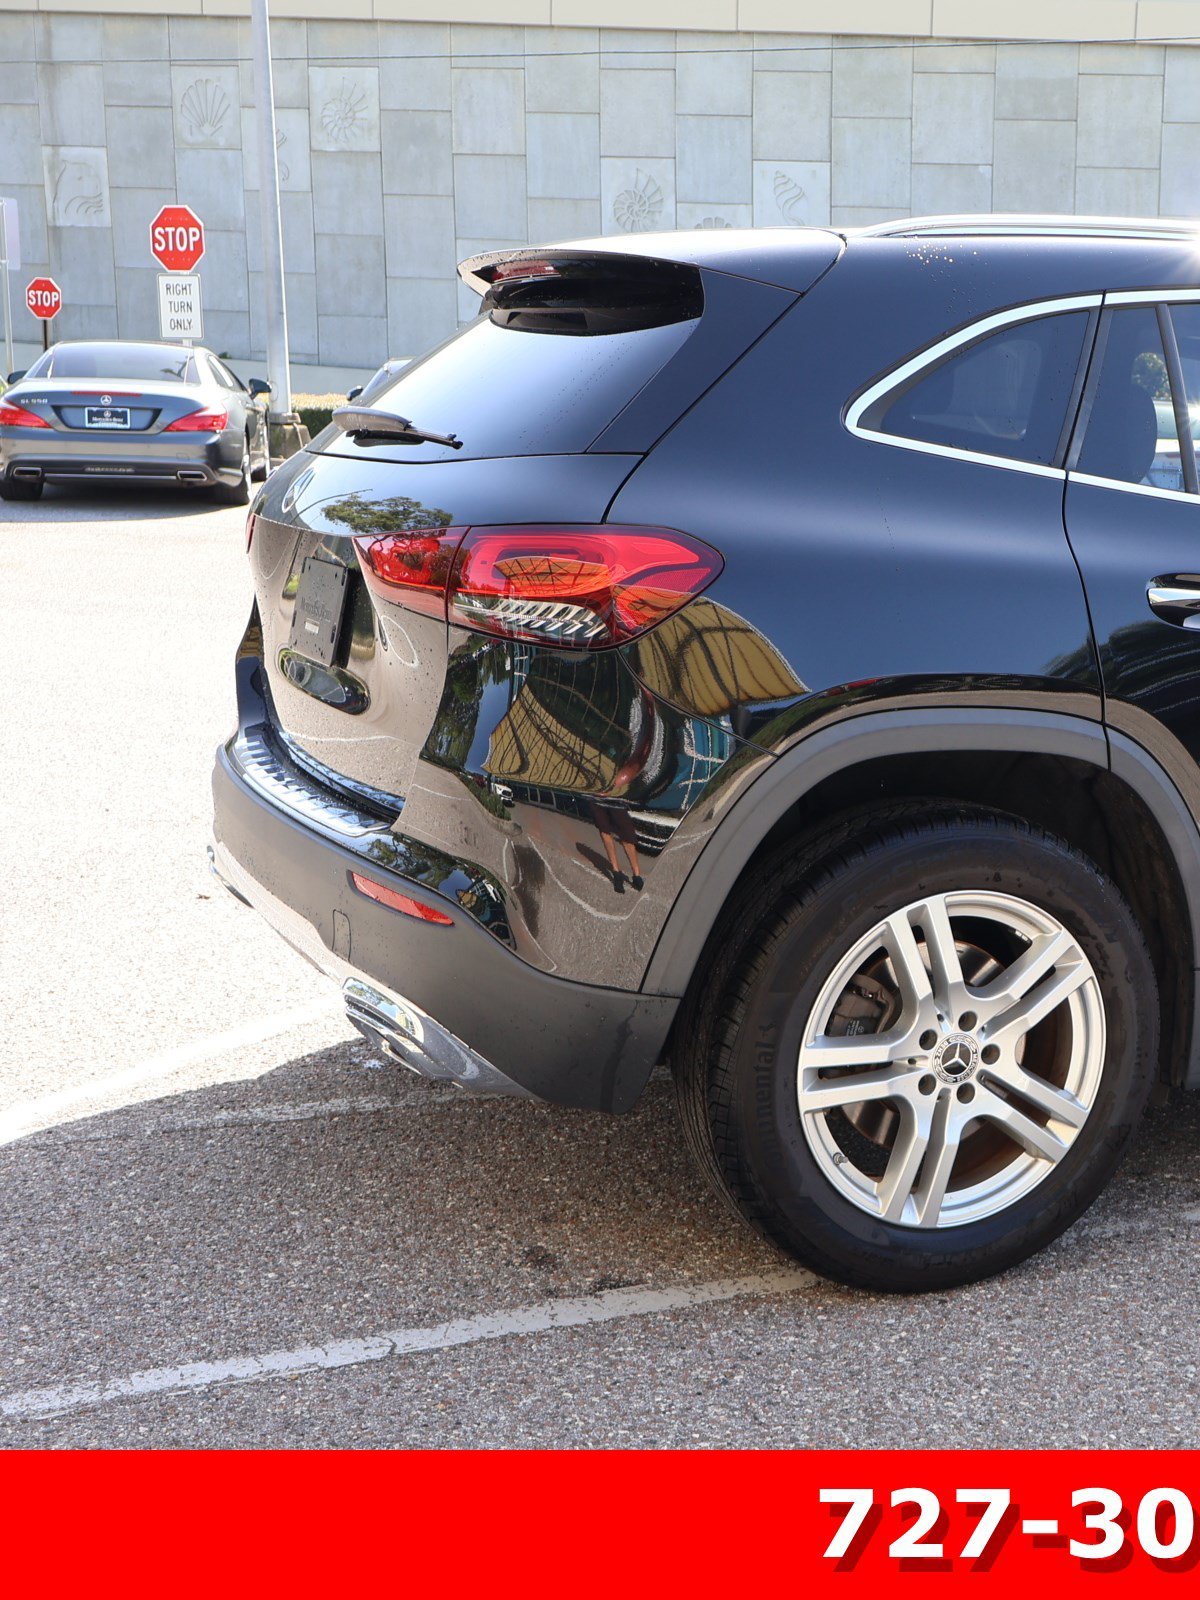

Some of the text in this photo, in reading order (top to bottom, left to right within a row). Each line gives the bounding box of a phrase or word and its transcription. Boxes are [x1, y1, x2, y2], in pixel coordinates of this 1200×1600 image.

[154, 226, 200, 252] STOP
[165, 283, 192, 296] RIGHT
[28, 289, 59, 308] STOP
[168, 300, 192, 313] TURN
[169, 318, 193, 330] ONLY
